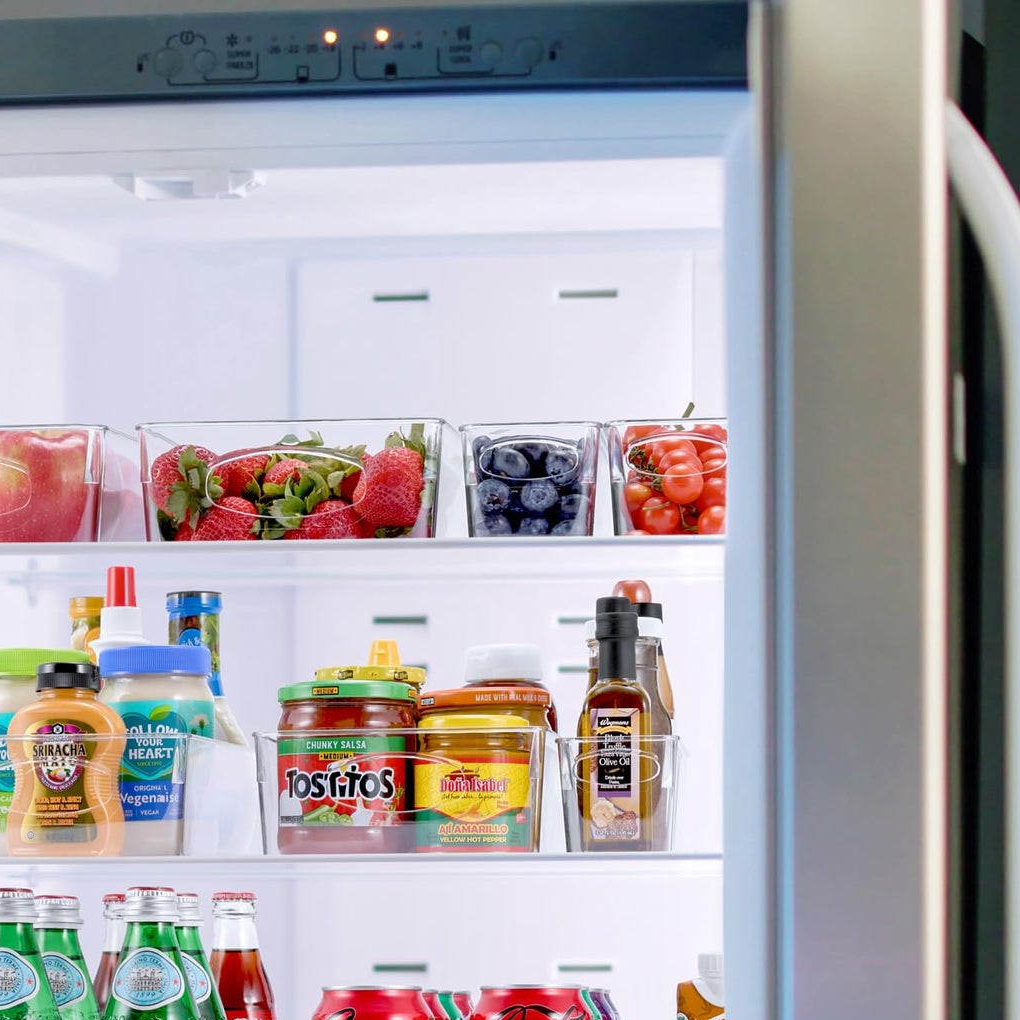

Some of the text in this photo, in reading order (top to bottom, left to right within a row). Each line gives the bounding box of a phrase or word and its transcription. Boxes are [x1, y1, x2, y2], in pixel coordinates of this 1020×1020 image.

[126, 724, 180, 736] OLLOW
[136, 738, 164, 747] YOUR
[306, 740, 367, 750] CHUNKY SALSA
[33, 743, 86, 757] SRIRACHA
[128, 747, 174, 760] HEART
[598, 757, 631, 766] Olive Oil
[454, 823, 509, 835] AMARILLO
